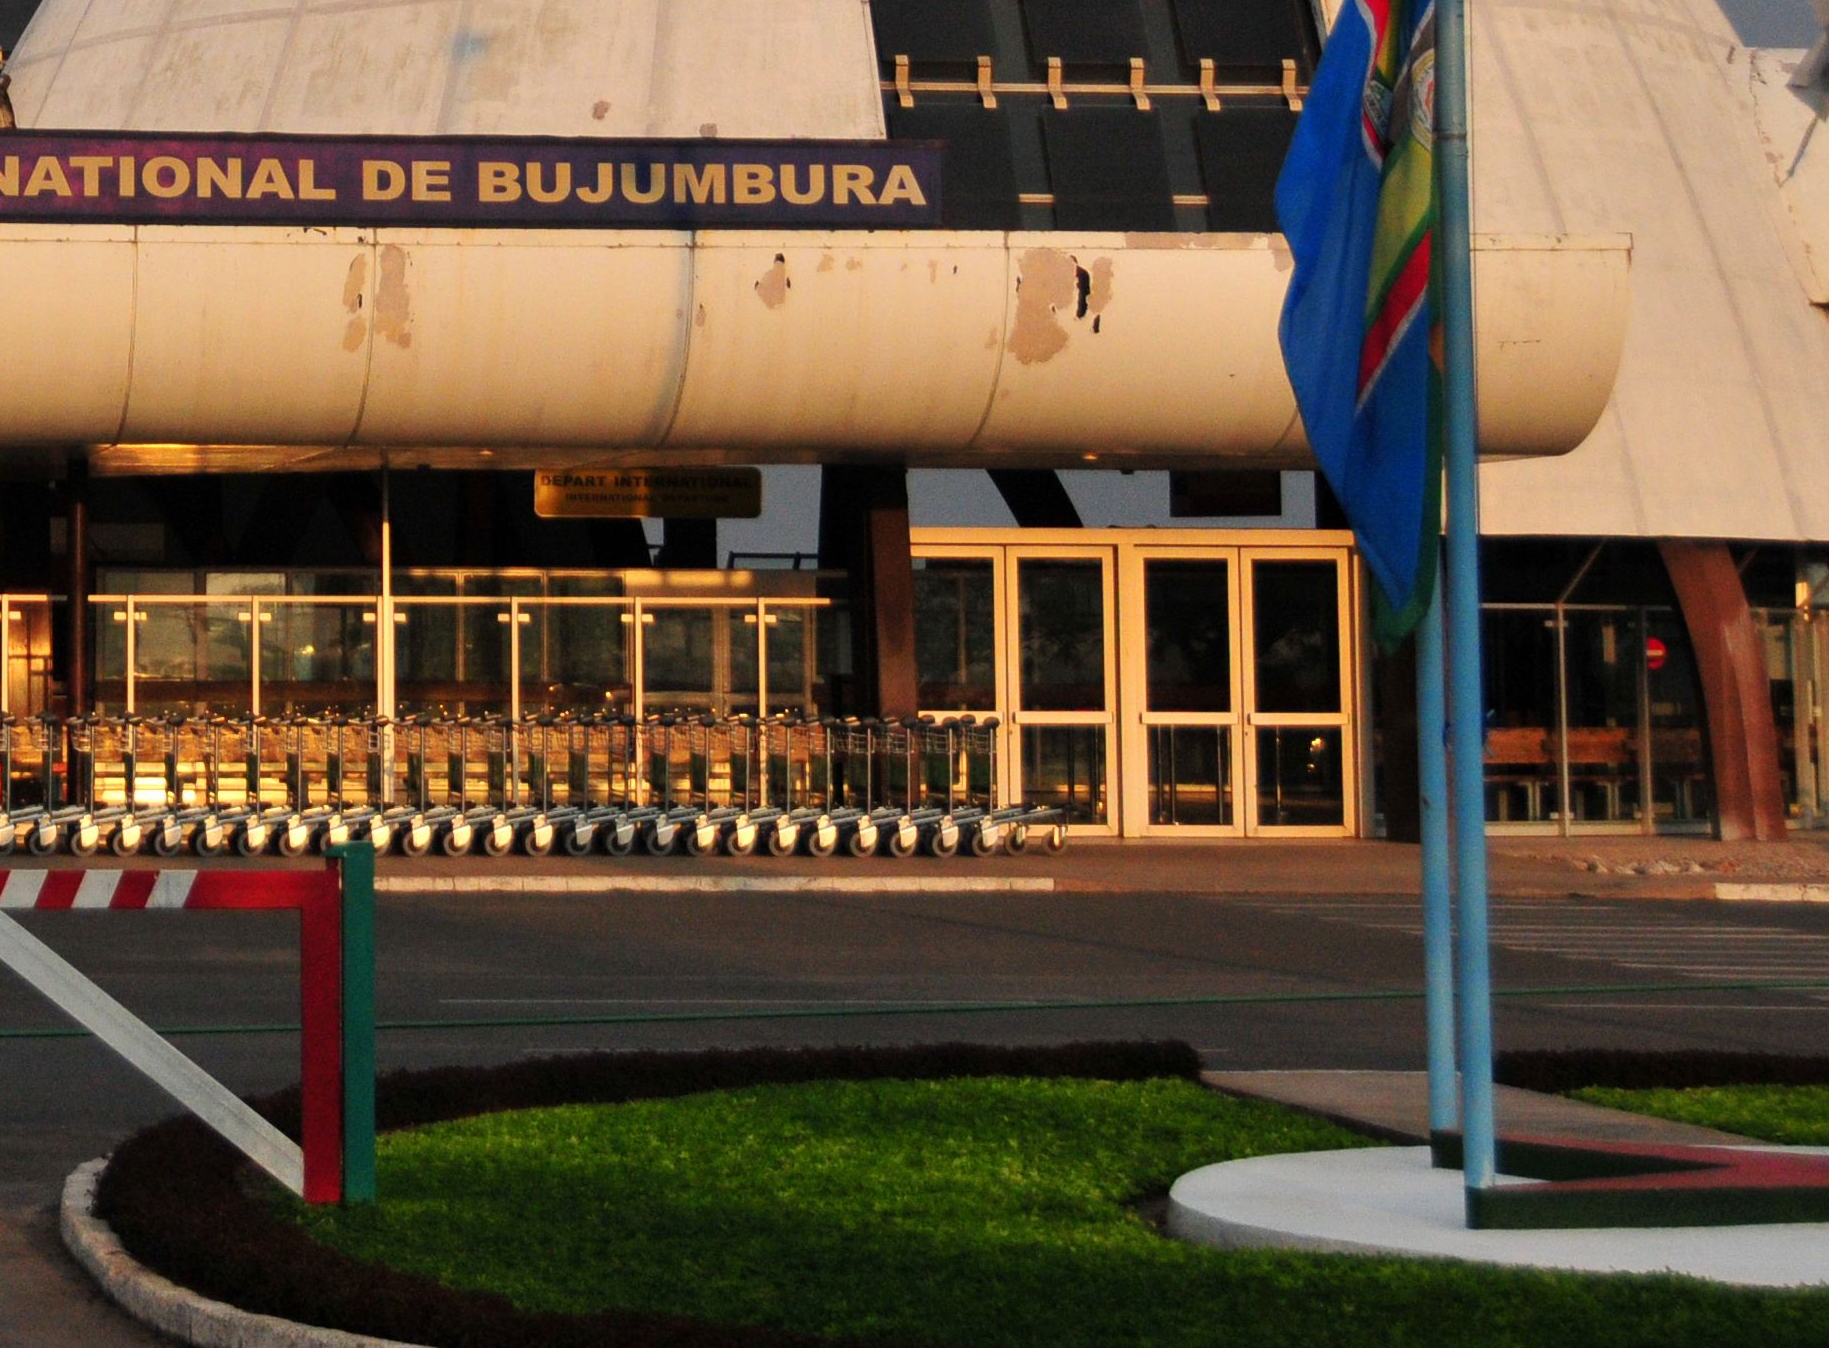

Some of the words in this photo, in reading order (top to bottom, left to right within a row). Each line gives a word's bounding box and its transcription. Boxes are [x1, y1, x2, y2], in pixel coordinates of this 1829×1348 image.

[362, 159, 452, 202] DE
[478, 161, 927, 206] BUJUMBURA
[540, 474, 607, 488] DEPART
[613, 474, 754, 489] INTERNATIONAL
[564, 492, 655, 502] INTERNATIONAL
